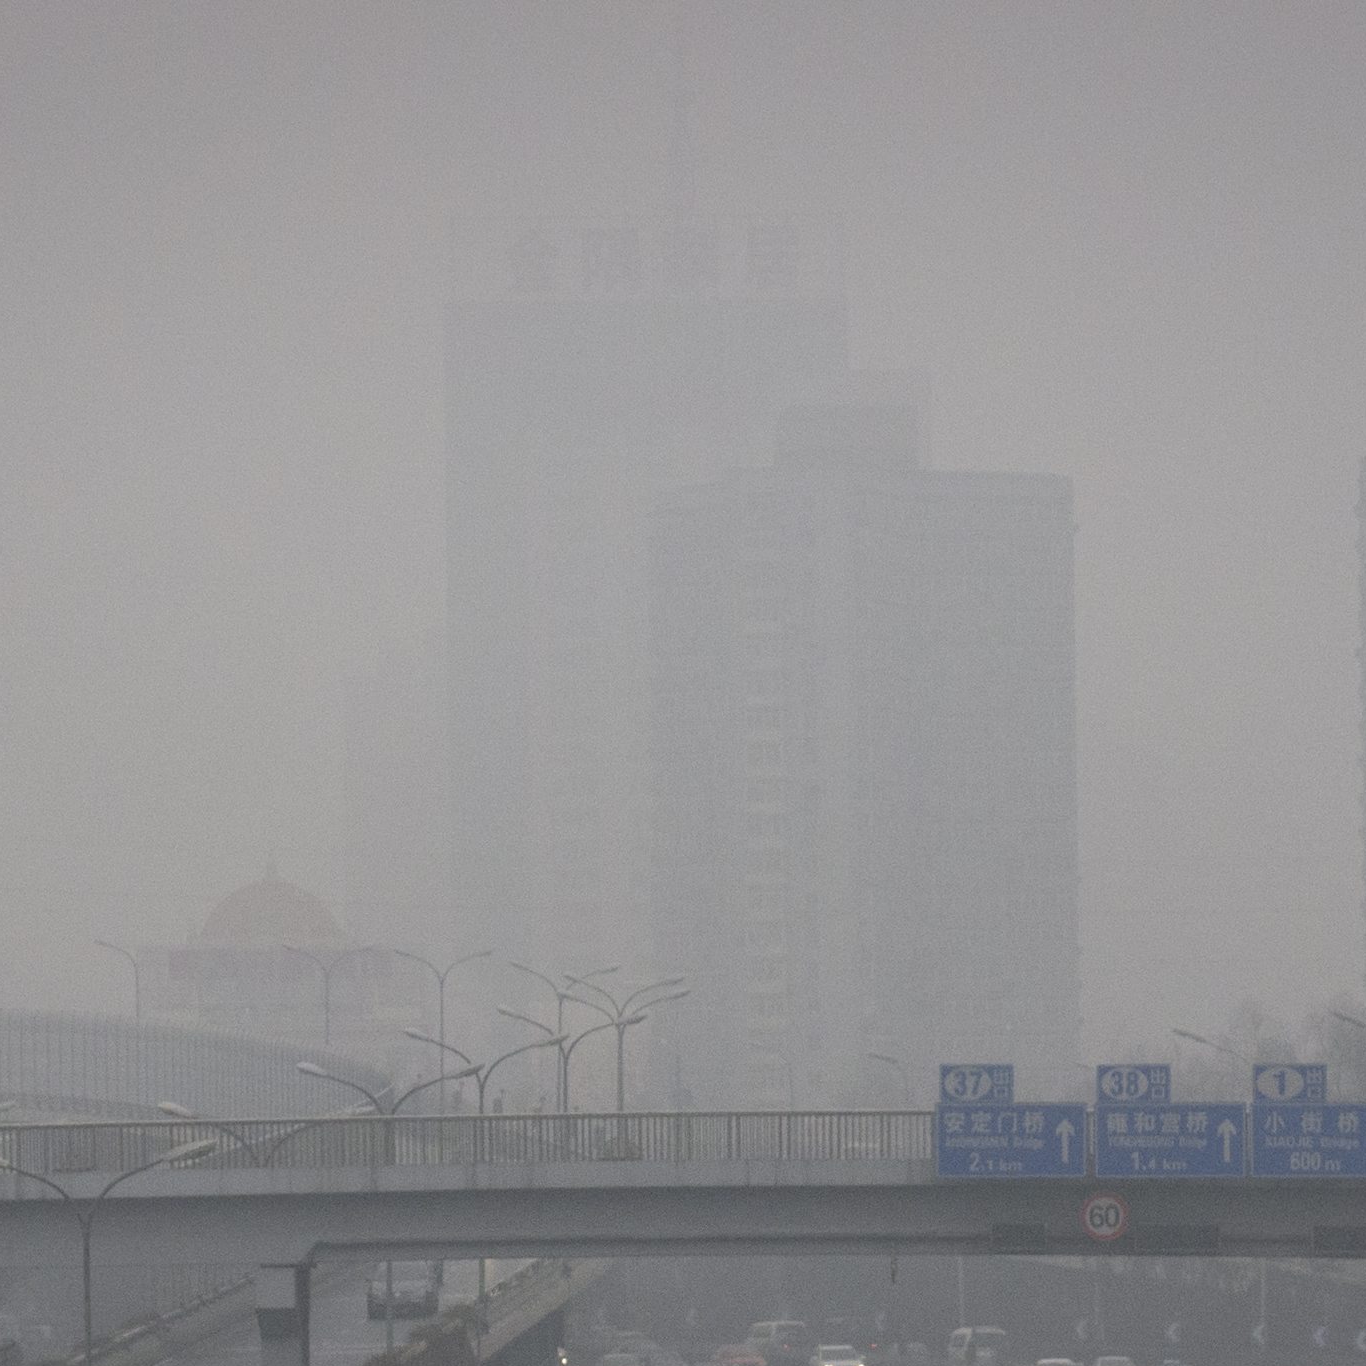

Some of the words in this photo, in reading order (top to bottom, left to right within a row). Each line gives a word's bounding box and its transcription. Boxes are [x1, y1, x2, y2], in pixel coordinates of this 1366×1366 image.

[954, 1071, 983, 1096] 37
[993, 1069, 1010, 1099] 出口
[1110, 1072, 1139, 1097] 38
[1150, 1068, 1167, 1099] 出口
[1273, 1071, 1286, 1096] 1
[1307, 1069, 1323, 1099] 出口
[944, 1111, 1045, 1134] 安定门桥
[1107, 1111, 1209, 1135] 雍和宫桥
[1264, 1111, 1360, 1132] 小街桥
[969, 1153, 992, 1171] 2.1
[998, 1157, 1022, 1171] km
[1131, 1152, 1154, 1171] 1.4
[1162, 1157, 1186, 1171] km
[1290, 1152, 1321, 1171] 600
[1324, 1158, 1341, 1171] m
[1089, 1203, 1120, 1229] 60
